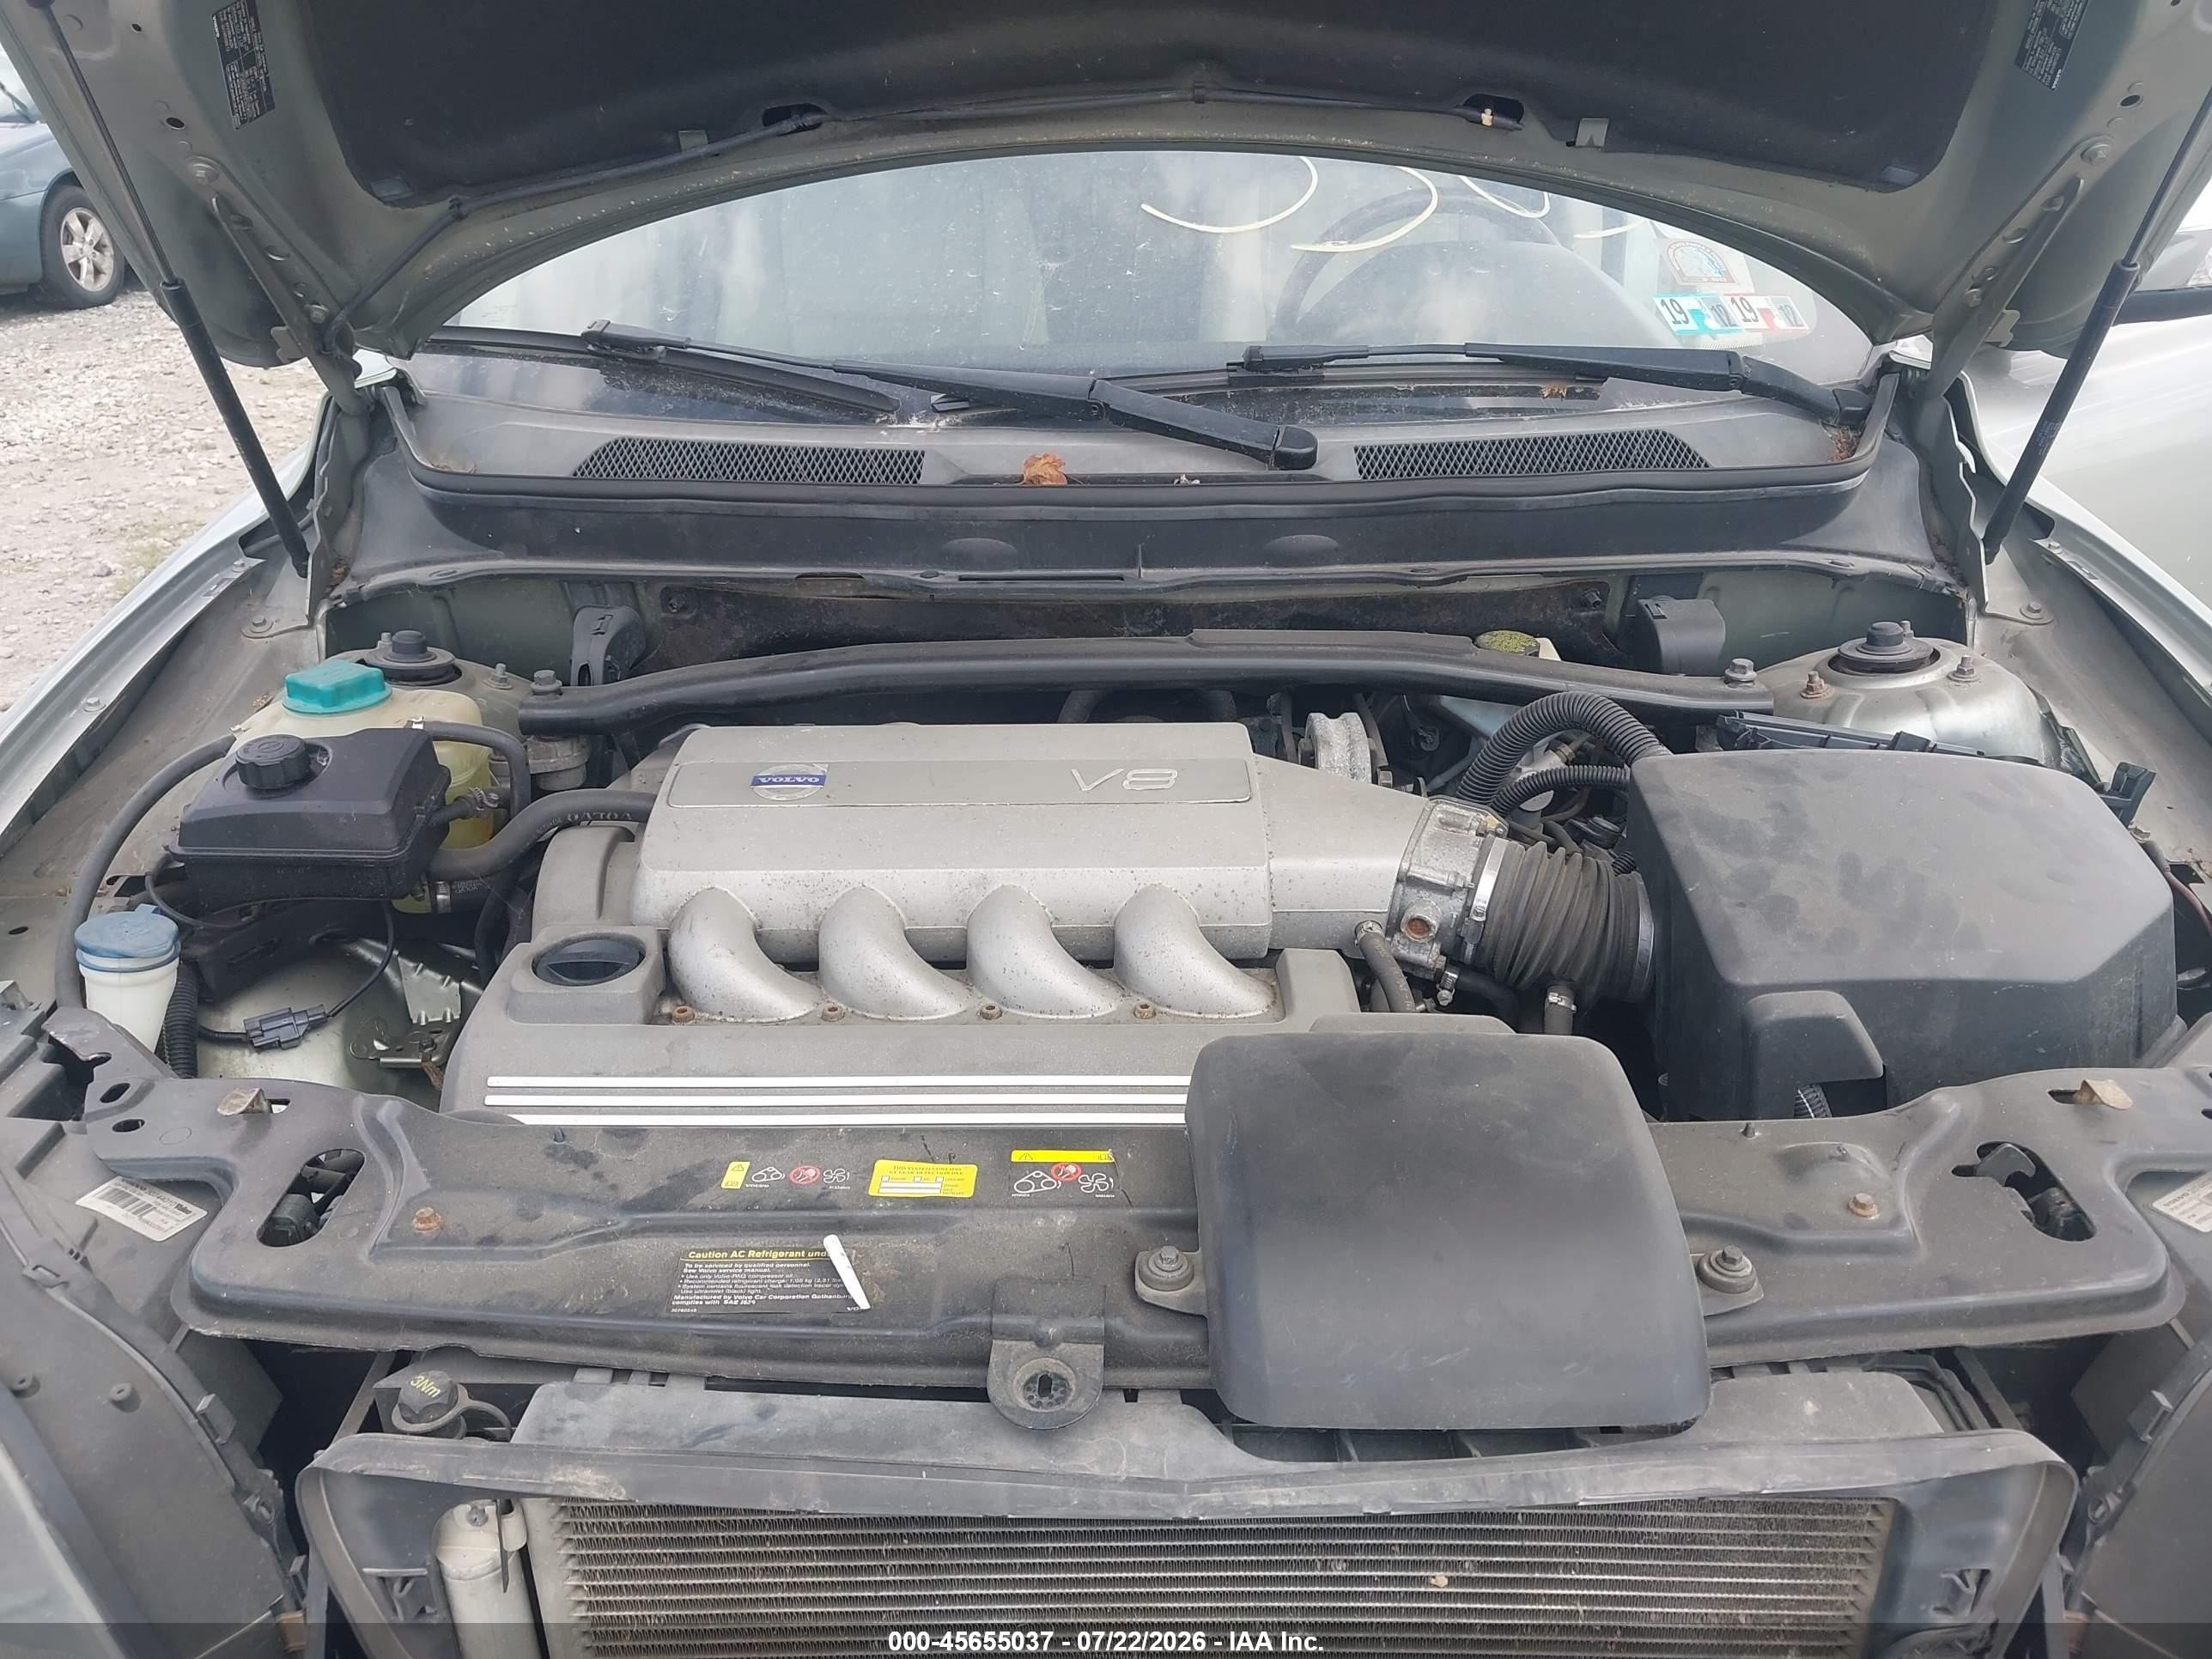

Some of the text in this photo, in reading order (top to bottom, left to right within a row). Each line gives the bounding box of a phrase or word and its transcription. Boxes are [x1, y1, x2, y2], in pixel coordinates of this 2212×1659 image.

[1660, 298, 1689, 325] 19
[1730, 297, 1759, 323] 19
[1071, 769, 1178, 791] V8
[410, 1375, 441, 1398] 3Nm
